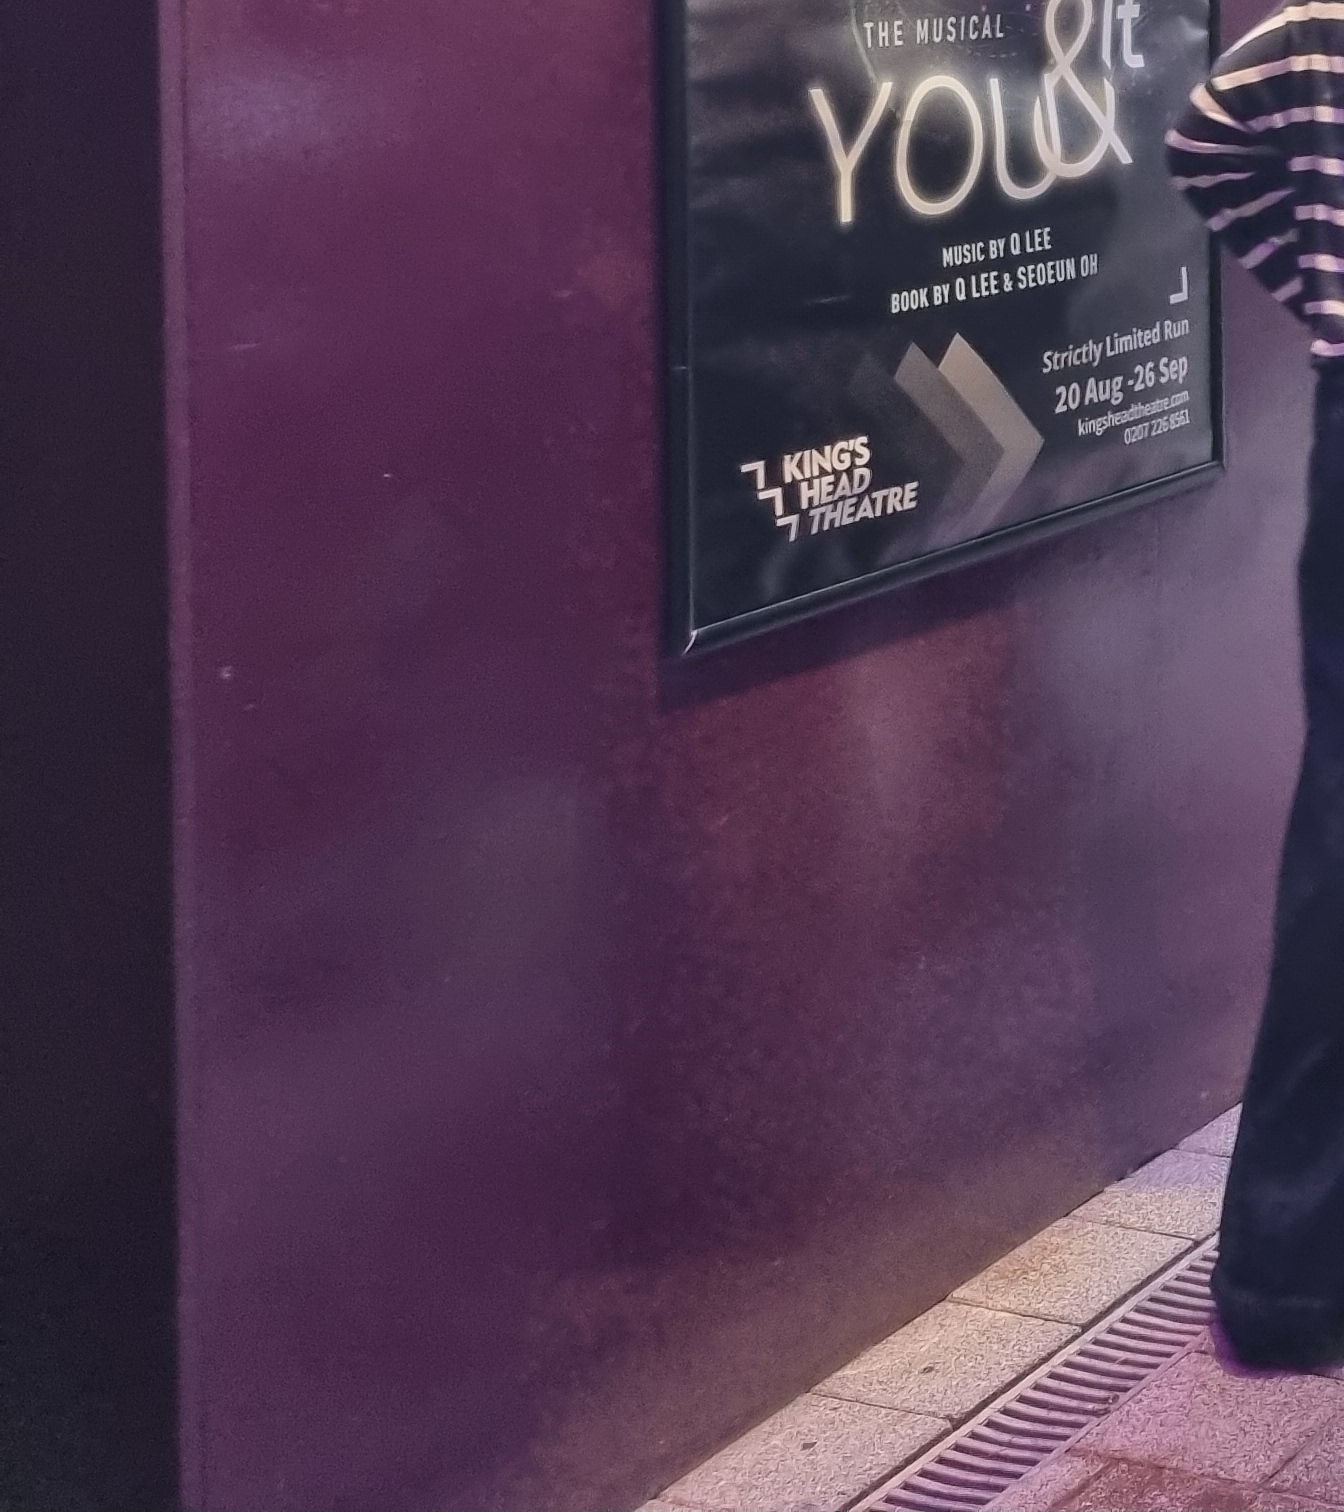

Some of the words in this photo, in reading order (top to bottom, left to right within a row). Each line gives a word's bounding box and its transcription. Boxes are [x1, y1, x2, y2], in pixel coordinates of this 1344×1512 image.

[864, 19, 904, 49] THE
[916, 13, 1004, 45] MUSICAL
[942, 241, 985, 268] MUSIC
[989, 237, 1006, 260] BY
[1010, 232, 1021, 256] Q
[1025, 227, 1052, 253] LEE
[891, 287, 930, 314] BOOK
[933, 282, 950, 306] BY
[955, 277, 967, 301] Q
[971, 270, 999, 298] LEE
[1003, 272, 1013, 292] &
[1017, 256, 1076, 289] SEOEUN
[1080, 253, 1099, 277] OH
[1042, 339, 1104, 374] Strictly
[1106, 320, 1160, 358] Limited
[1164, 319, 1190, 341] Run
[1054, 382, 1081, 414] 20
[1084, 375, 1124, 406] Aug
[1159, 355, 1188, 384] Sep
[1077, 390, 1190, 437] kingsheadtheatre.com
[783, 435, 871, 484] KING'S
[800, 468, 872, 510] HEAD
[808, 481, 920, 536] THEATRE
